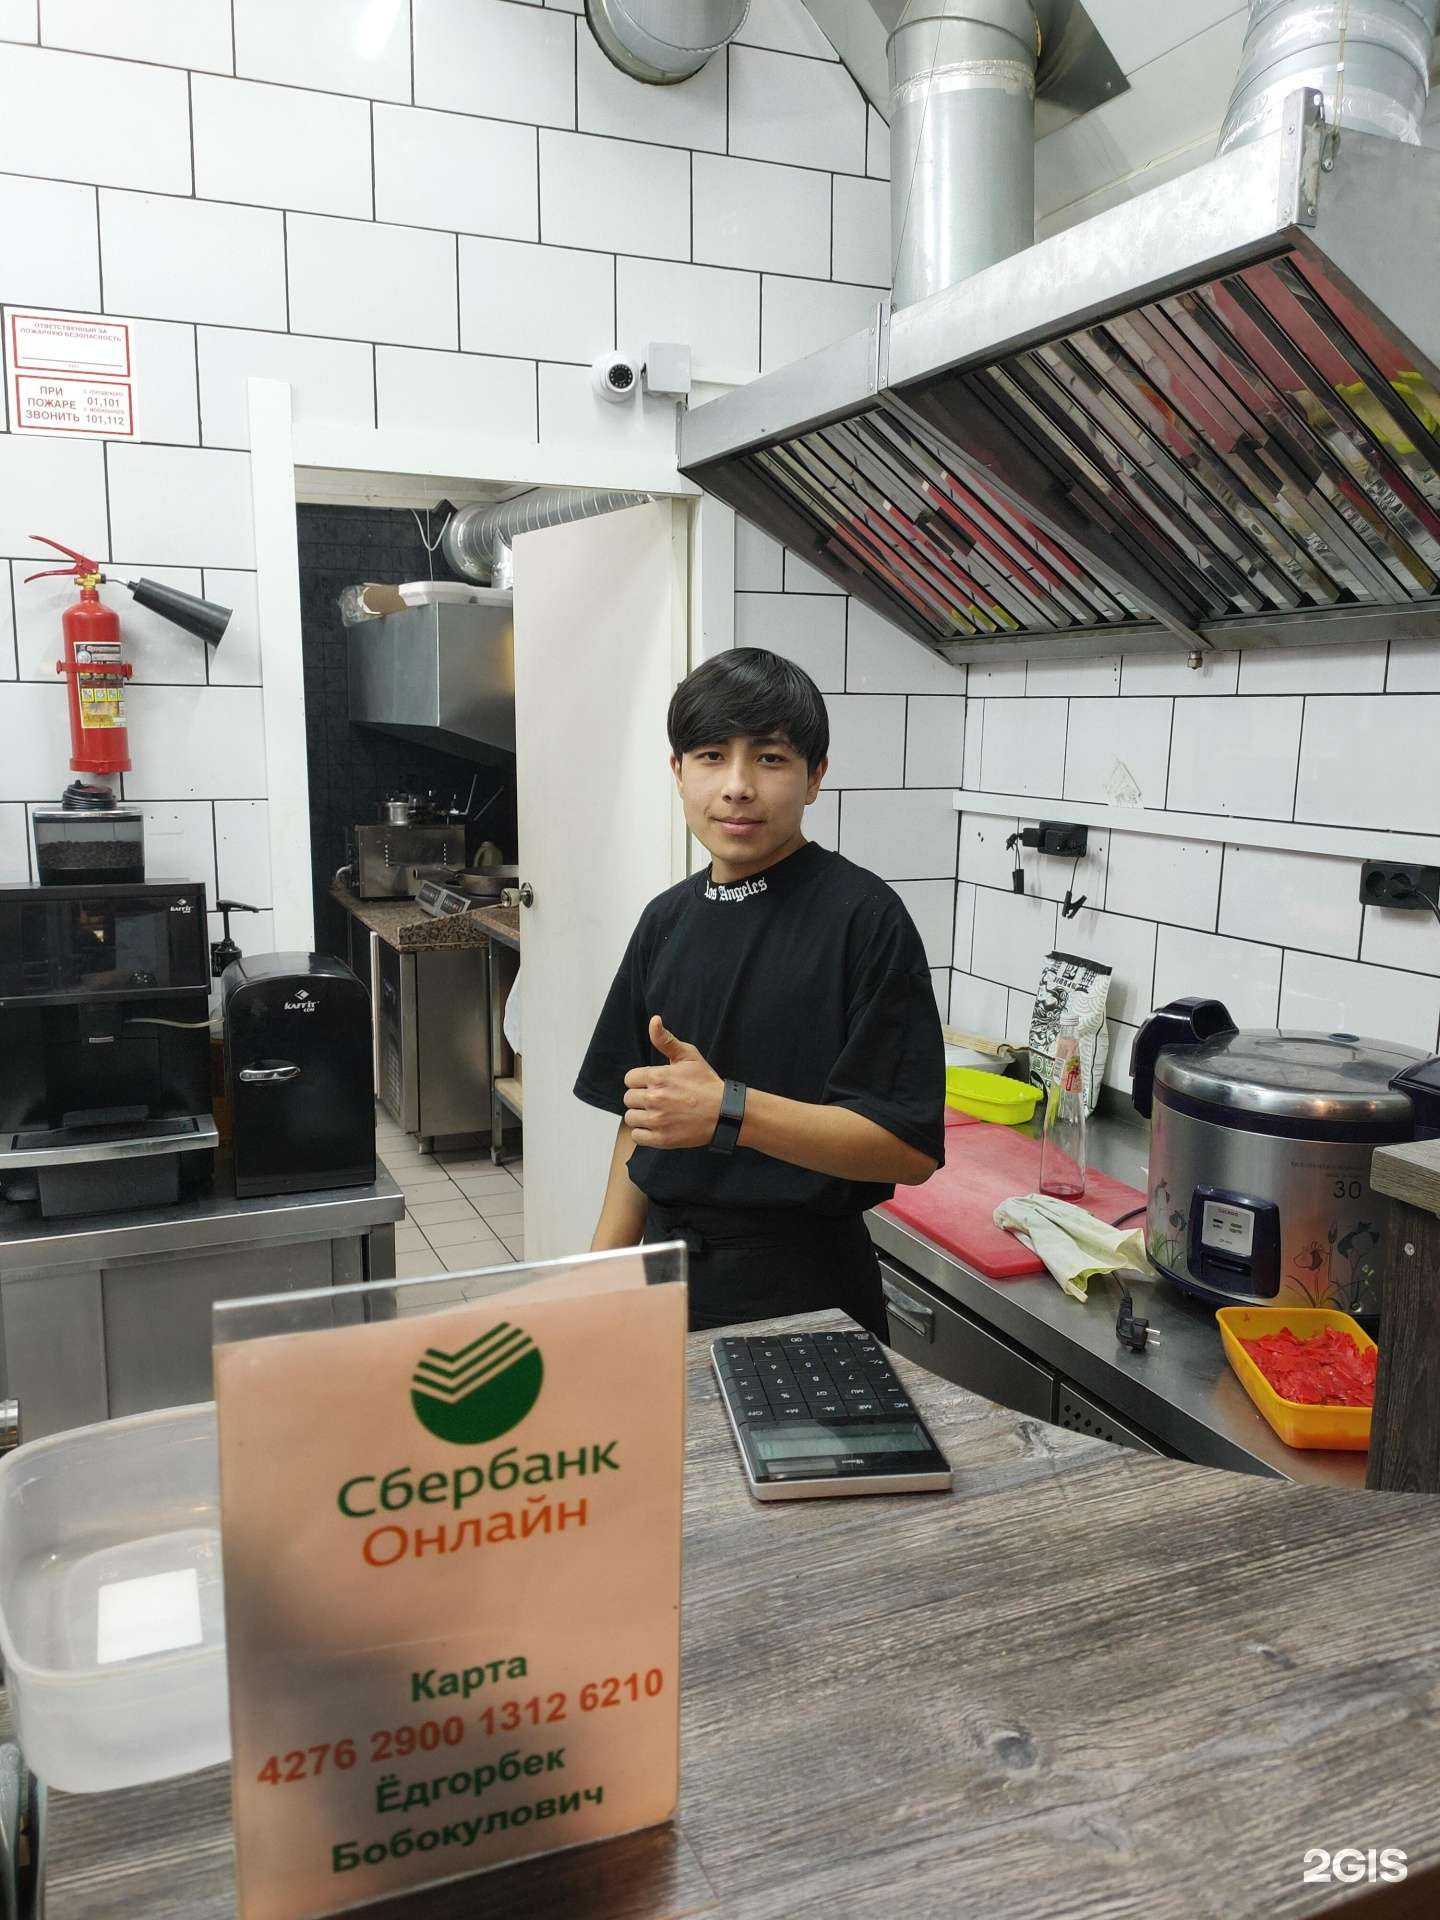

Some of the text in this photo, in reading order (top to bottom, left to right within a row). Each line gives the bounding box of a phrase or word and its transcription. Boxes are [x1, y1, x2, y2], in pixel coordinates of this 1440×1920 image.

[27, 397, 77, 410] ПОЖАРЕ
[40, 386, 63, 396] ПРИ
[25, 409, 80, 422] ЗВОНИТЬ
[86, 414, 125, 426] 101,112
[718, 877, 768, 903] Angeles
[1333, 1180, 1361, 1200] 30
[336, 1440, 620, 1518] Сбербанк
[362, 1494, 588, 1568] Онлайн
[410, 1655, 528, 1701] Карта
[256, 1668, 664, 1786] 4276 2900 1312 6210
[375, 1745, 567, 1813] Ёдгорбек
[332, 1786, 605, 1873] Бобокулович
